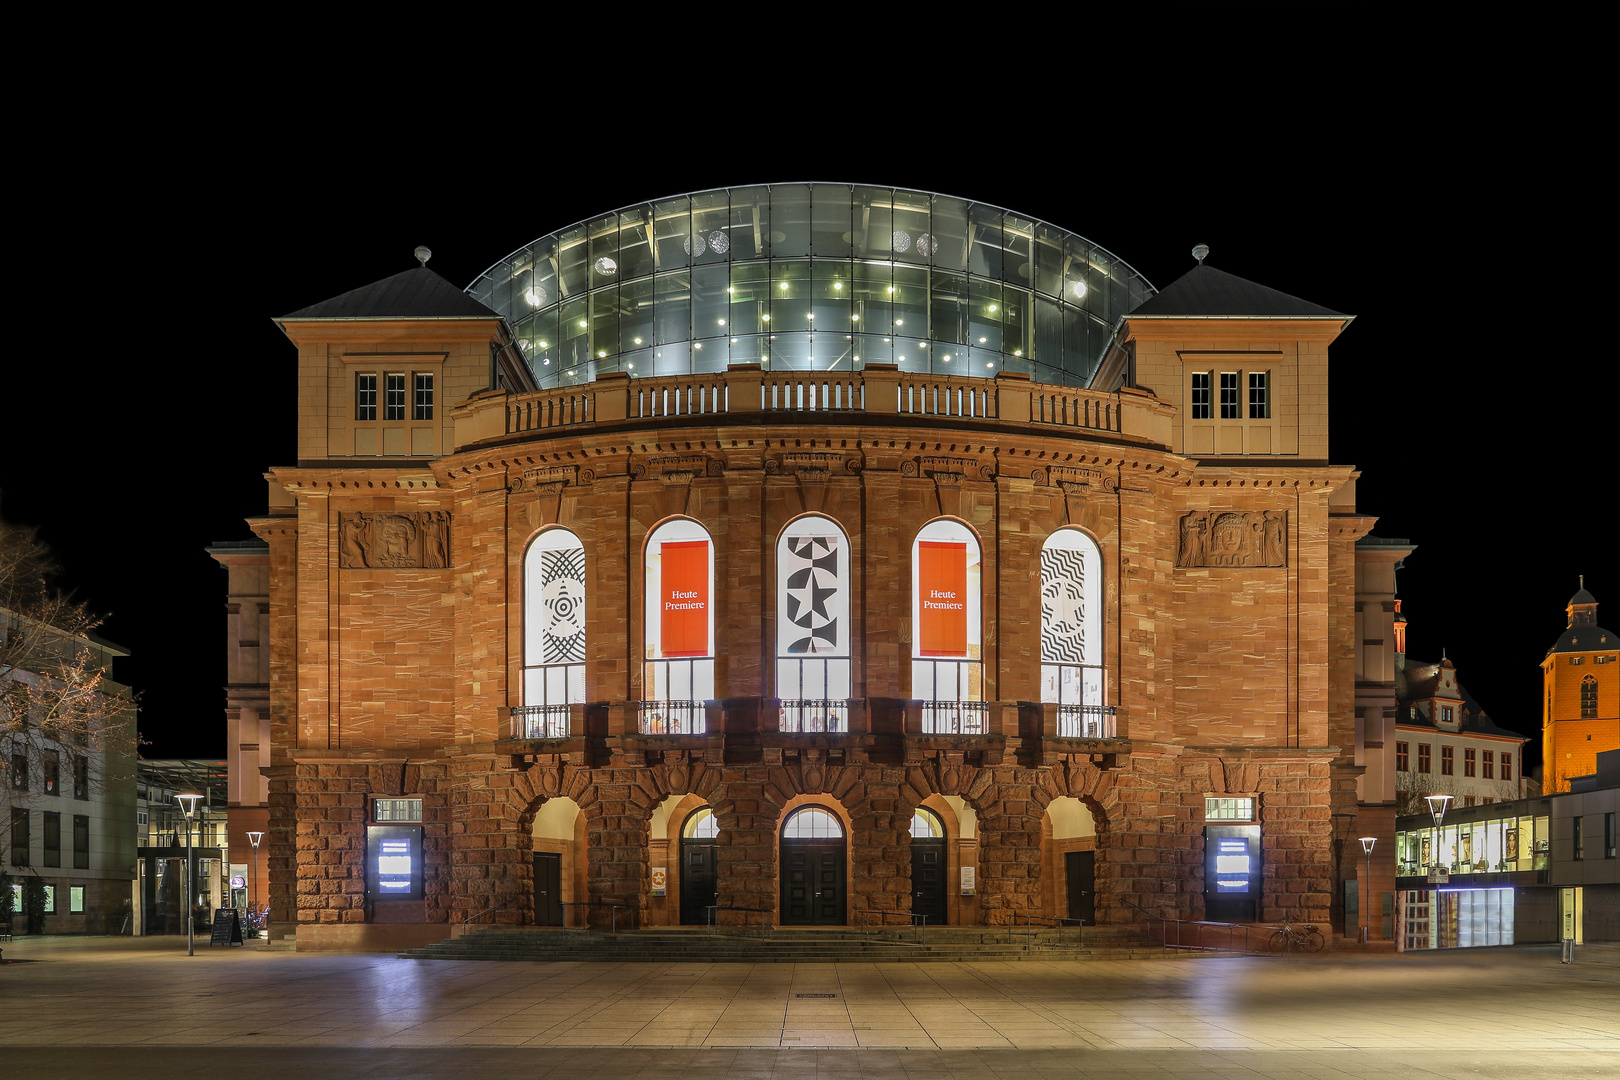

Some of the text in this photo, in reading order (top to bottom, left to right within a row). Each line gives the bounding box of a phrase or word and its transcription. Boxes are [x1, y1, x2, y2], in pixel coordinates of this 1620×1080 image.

[672, 591, 698, 599] Heute
[930, 590, 956, 599] Heute
[665, 601, 705, 610] Premiere
[924, 600, 963, 610] Premiere
